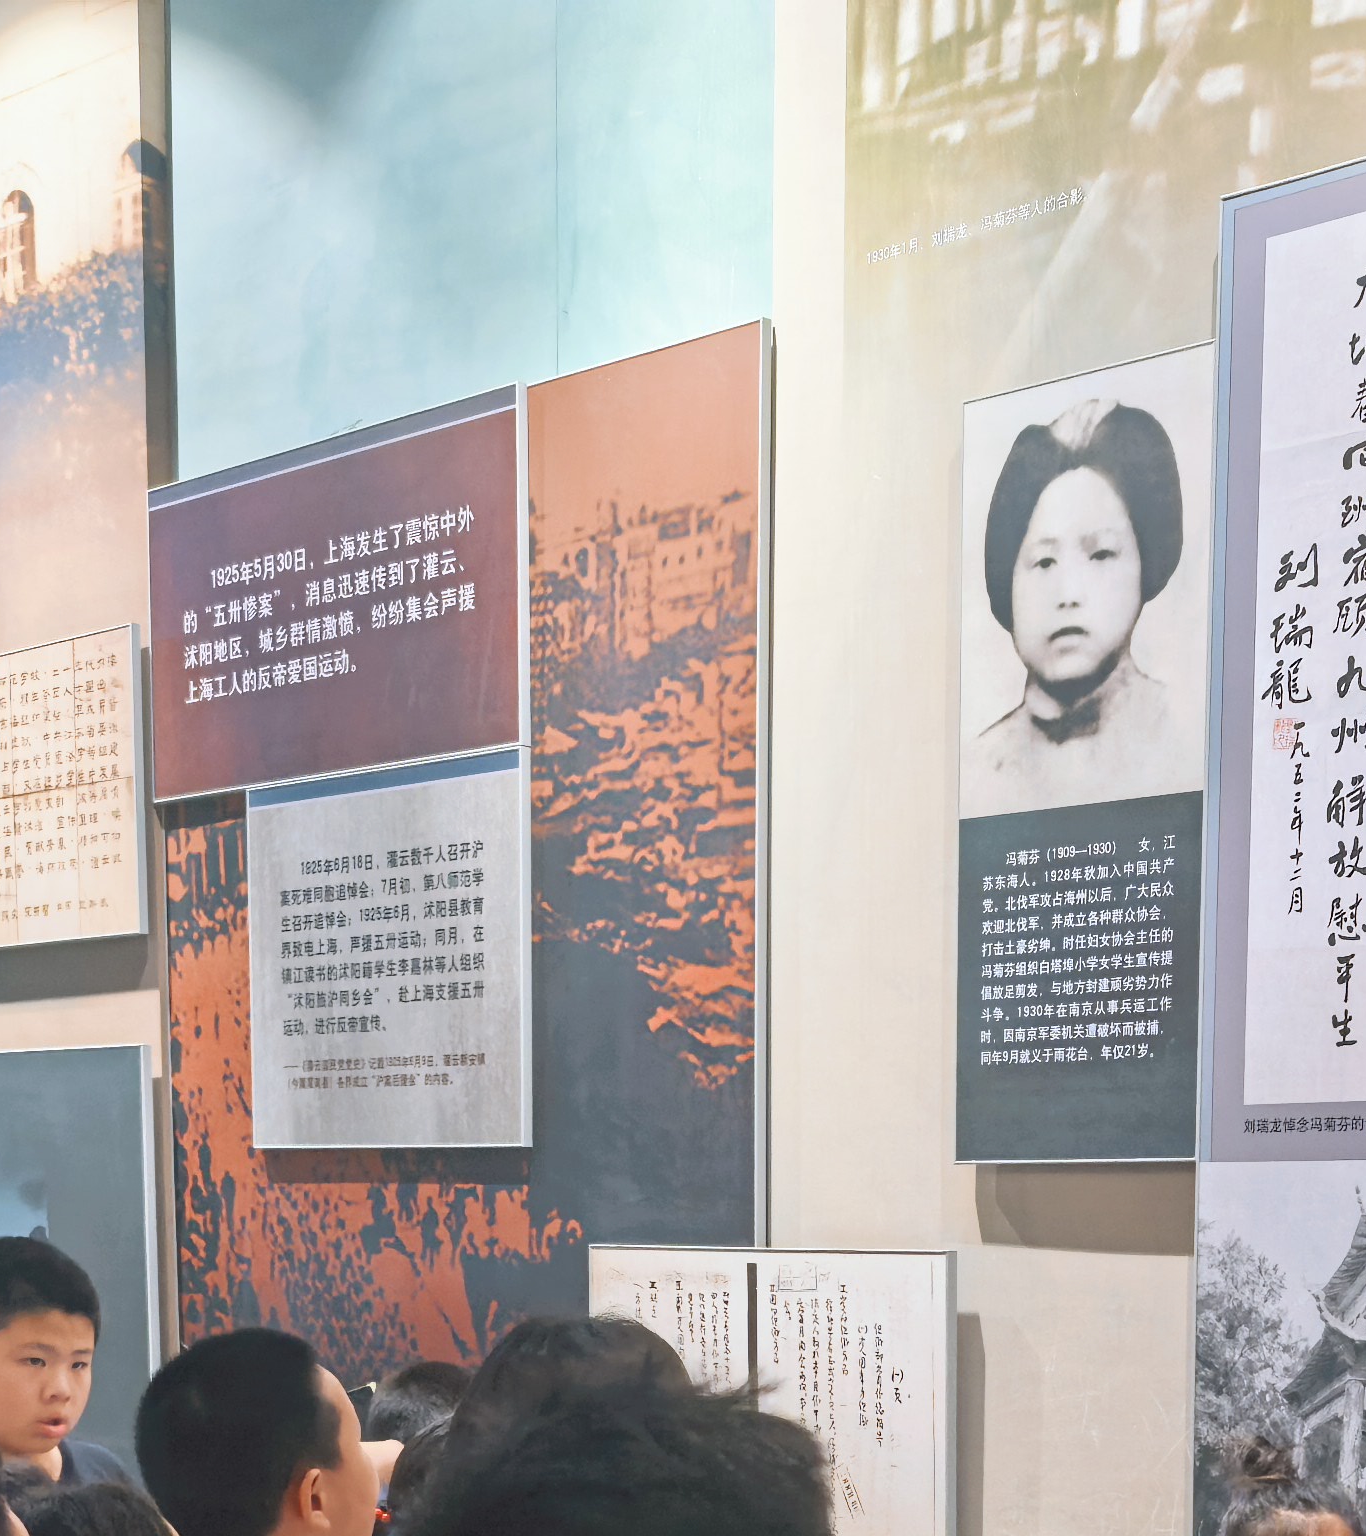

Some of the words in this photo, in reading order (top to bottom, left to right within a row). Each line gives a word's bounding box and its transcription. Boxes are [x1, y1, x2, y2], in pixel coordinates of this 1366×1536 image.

[185, 648, 358, 704] 上海工人的反帝爱国运动。
